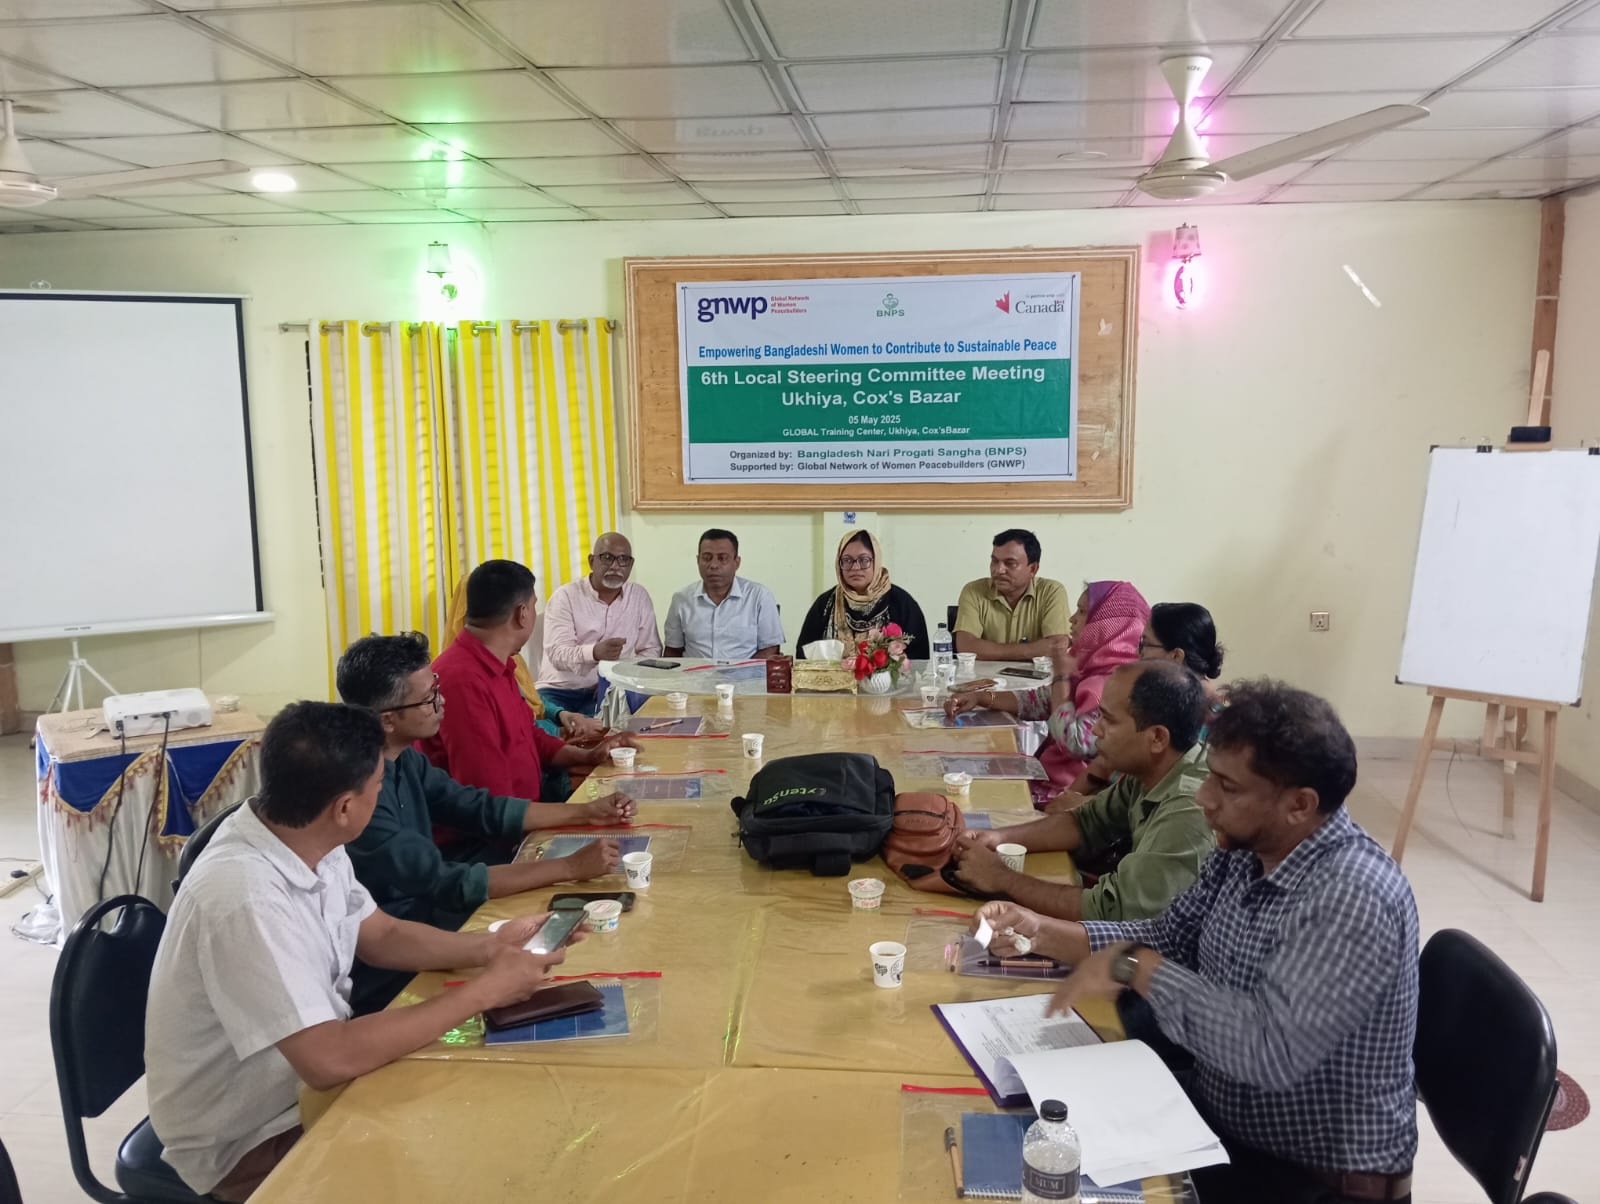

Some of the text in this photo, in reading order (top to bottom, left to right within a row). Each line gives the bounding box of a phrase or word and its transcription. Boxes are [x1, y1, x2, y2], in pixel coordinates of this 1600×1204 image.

[697, 296, 768, 322] gnwp
[876, 309, 904, 317] BNPS
[1015, 299, 1065, 314] Canada
[699, 339, 1056, 360] Empowering Bangladeshi Women to Contribute to Sustainable Peace
[701, 366, 1045, 385] 6th Local Steering Committee Meeting
[782, 390, 961, 408] Ukhiya, Cox's Bazar
[849, 415, 901, 425] 05 May 2025
[821, 428, 854, 437] Training
[857, 427, 886, 436] Center,
[889, 427, 919, 436] Ukhiya,
[730, 447, 1026, 459] Organized by: Bangladesh Nari Progati Sangha (BNPS)
[730, 460, 1025, 472] Supported by: Global Network of Women Peacebuilders (GNWP)
